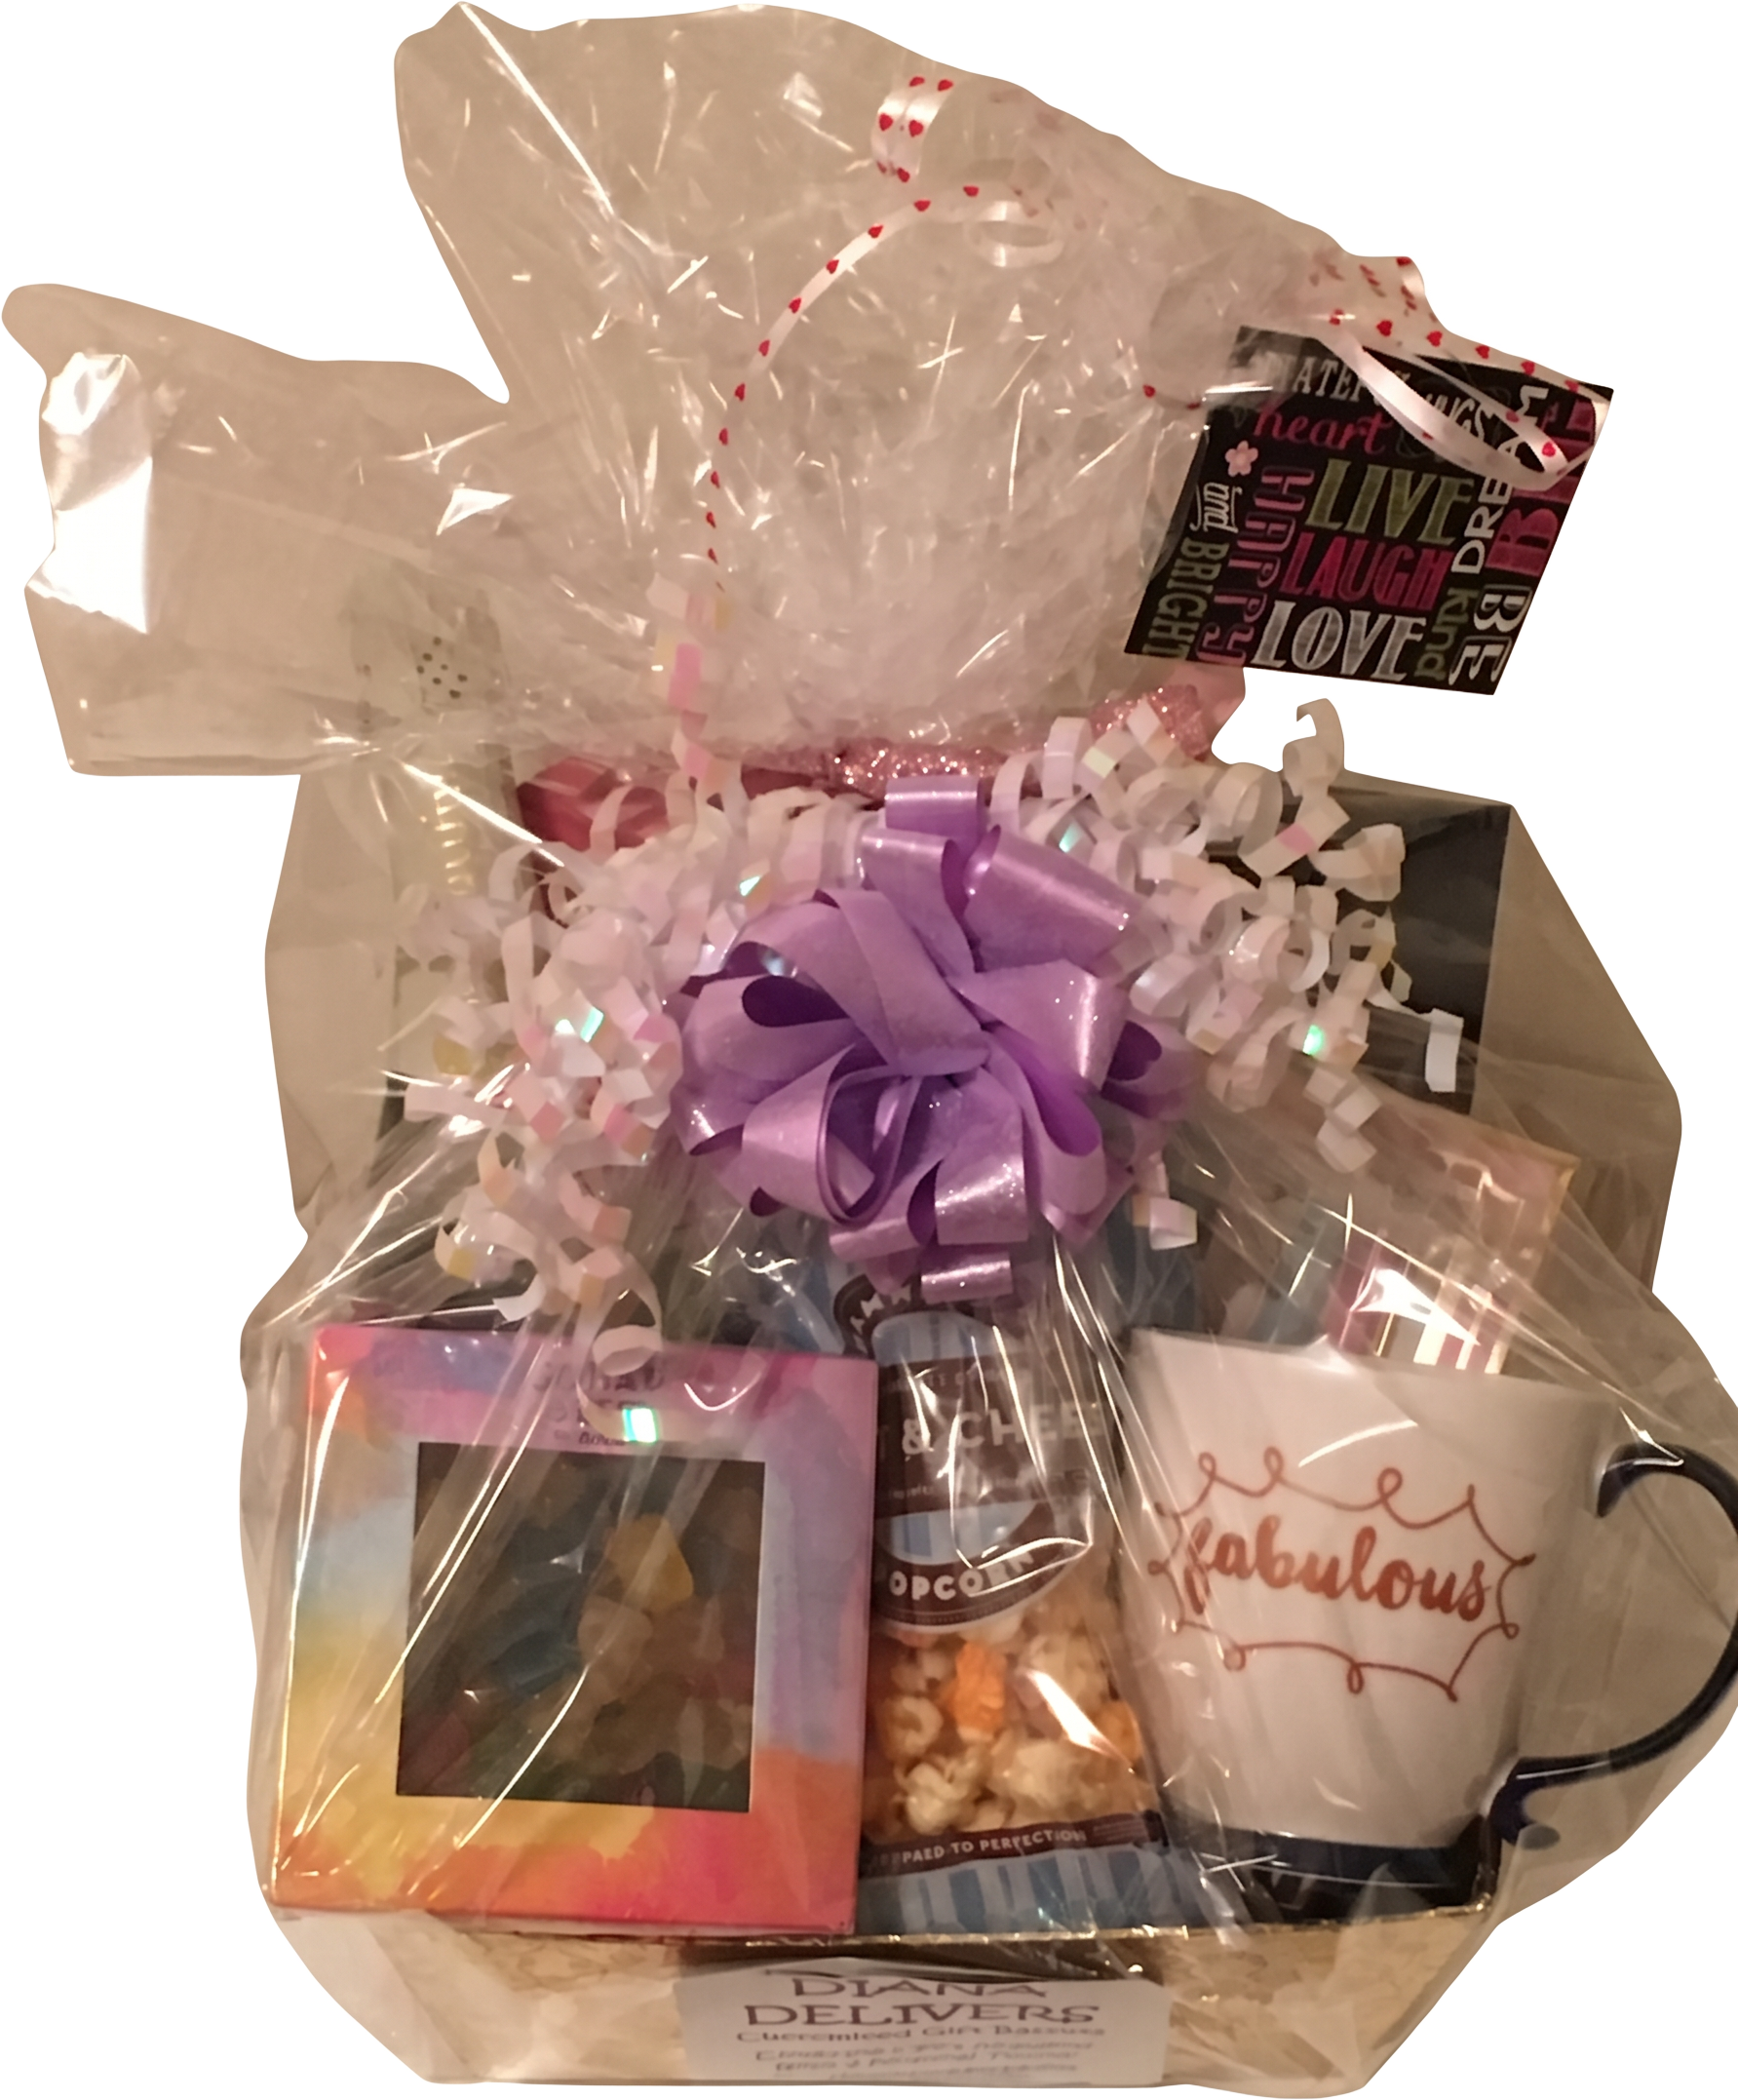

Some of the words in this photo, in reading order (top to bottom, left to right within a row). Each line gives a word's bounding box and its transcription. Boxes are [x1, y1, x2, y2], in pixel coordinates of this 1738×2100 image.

[1253, 398, 1394, 455] heart
[1198, 482, 1241, 534] and
[1304, 457, 1475, 546] LIVE
[1141, 536, 1230, 661] BRIGHT
[1196, 465, 1315, 667] HAPPY
[1278, 531, 1455, 611] LAUGH
[1250, 599, 1427, 682] LOVE
[1448, 583, 1535, 686] BE
[1183, 1514, 1492, 1622] fabulous
[950, 1840, 975, 1854] TO
[980, 1828, 1088, 1853] PERFECTION
[744, 2002, 1101, 2026] DELIVERS
[792, 1977, 1048, 1998] DIANA
